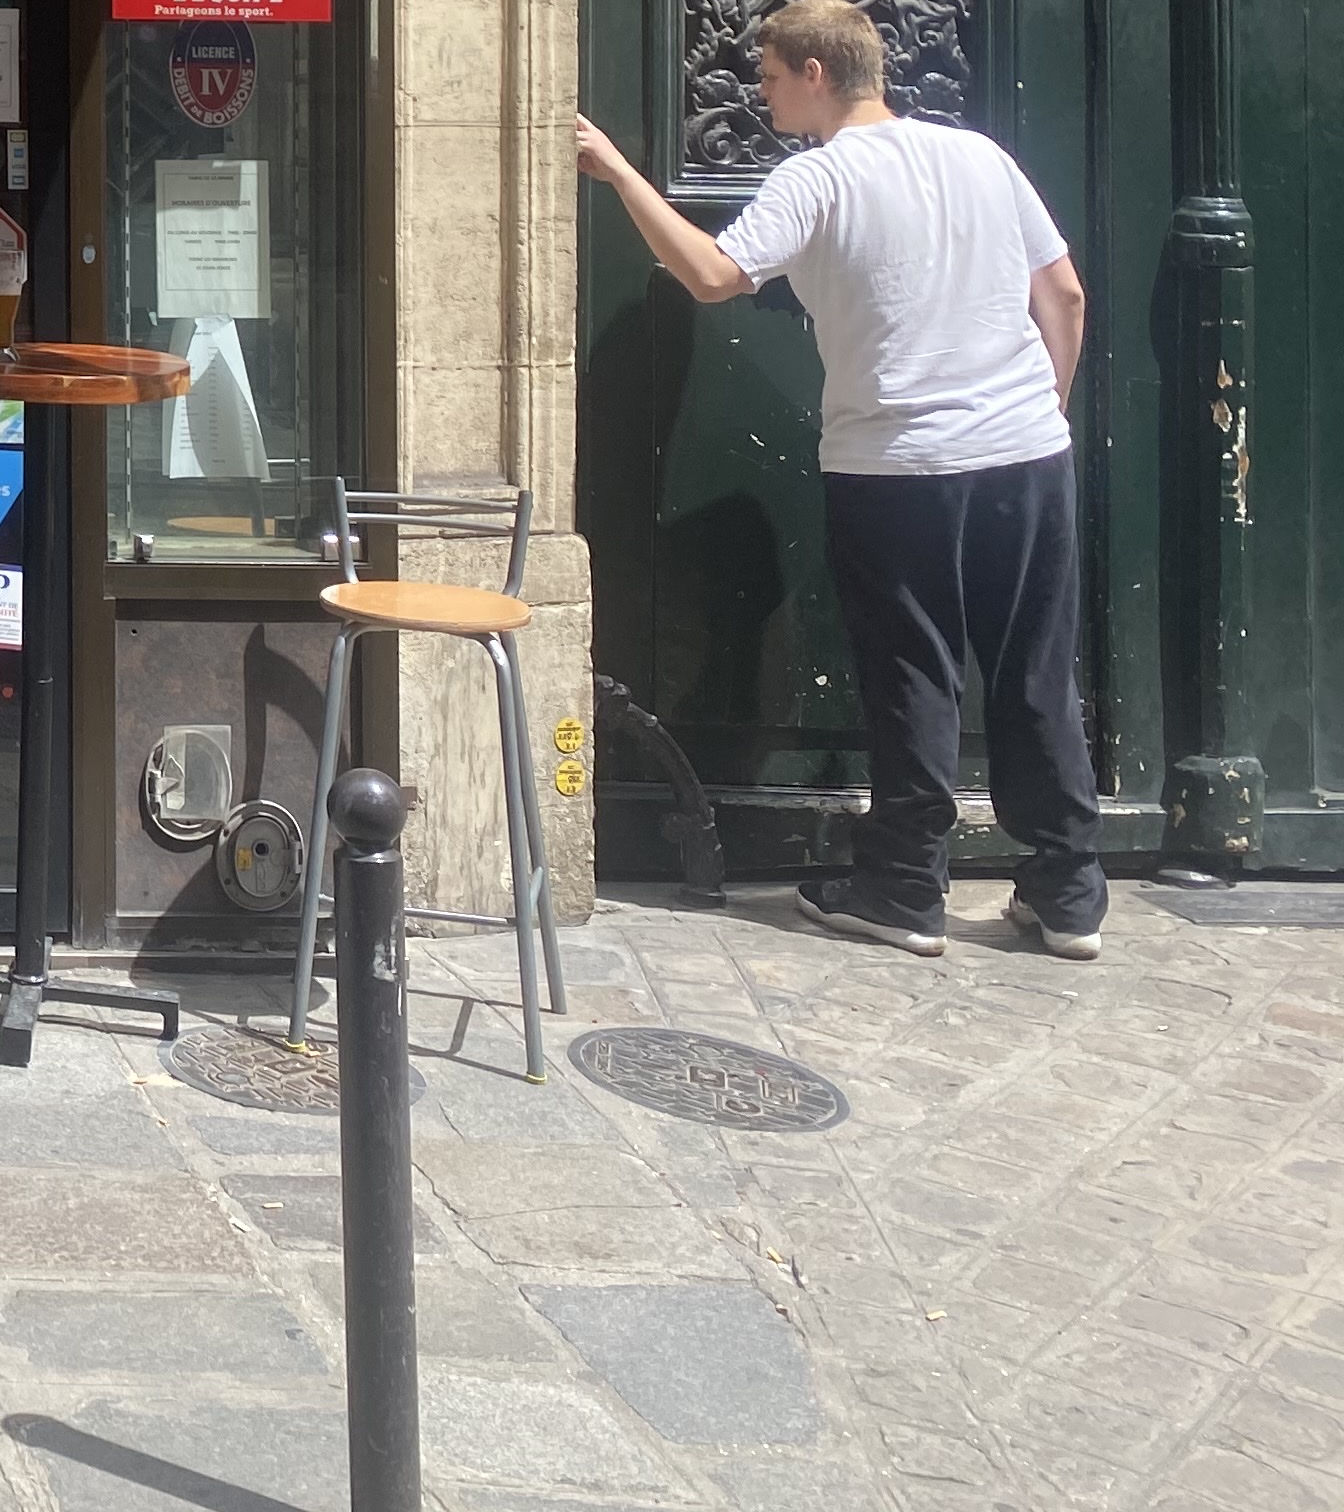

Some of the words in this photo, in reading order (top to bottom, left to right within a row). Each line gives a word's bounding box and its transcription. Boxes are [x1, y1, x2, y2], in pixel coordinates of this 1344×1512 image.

[154, 4, 222, 17] Partageons
[224, 5, 235, 16] le
[238, 6, 274, 18] sport.
[191, 46, 236, 59] LICENCE
[199, 68, 234, 96] IV
[203, 68, 254, 124] BOISSONS
